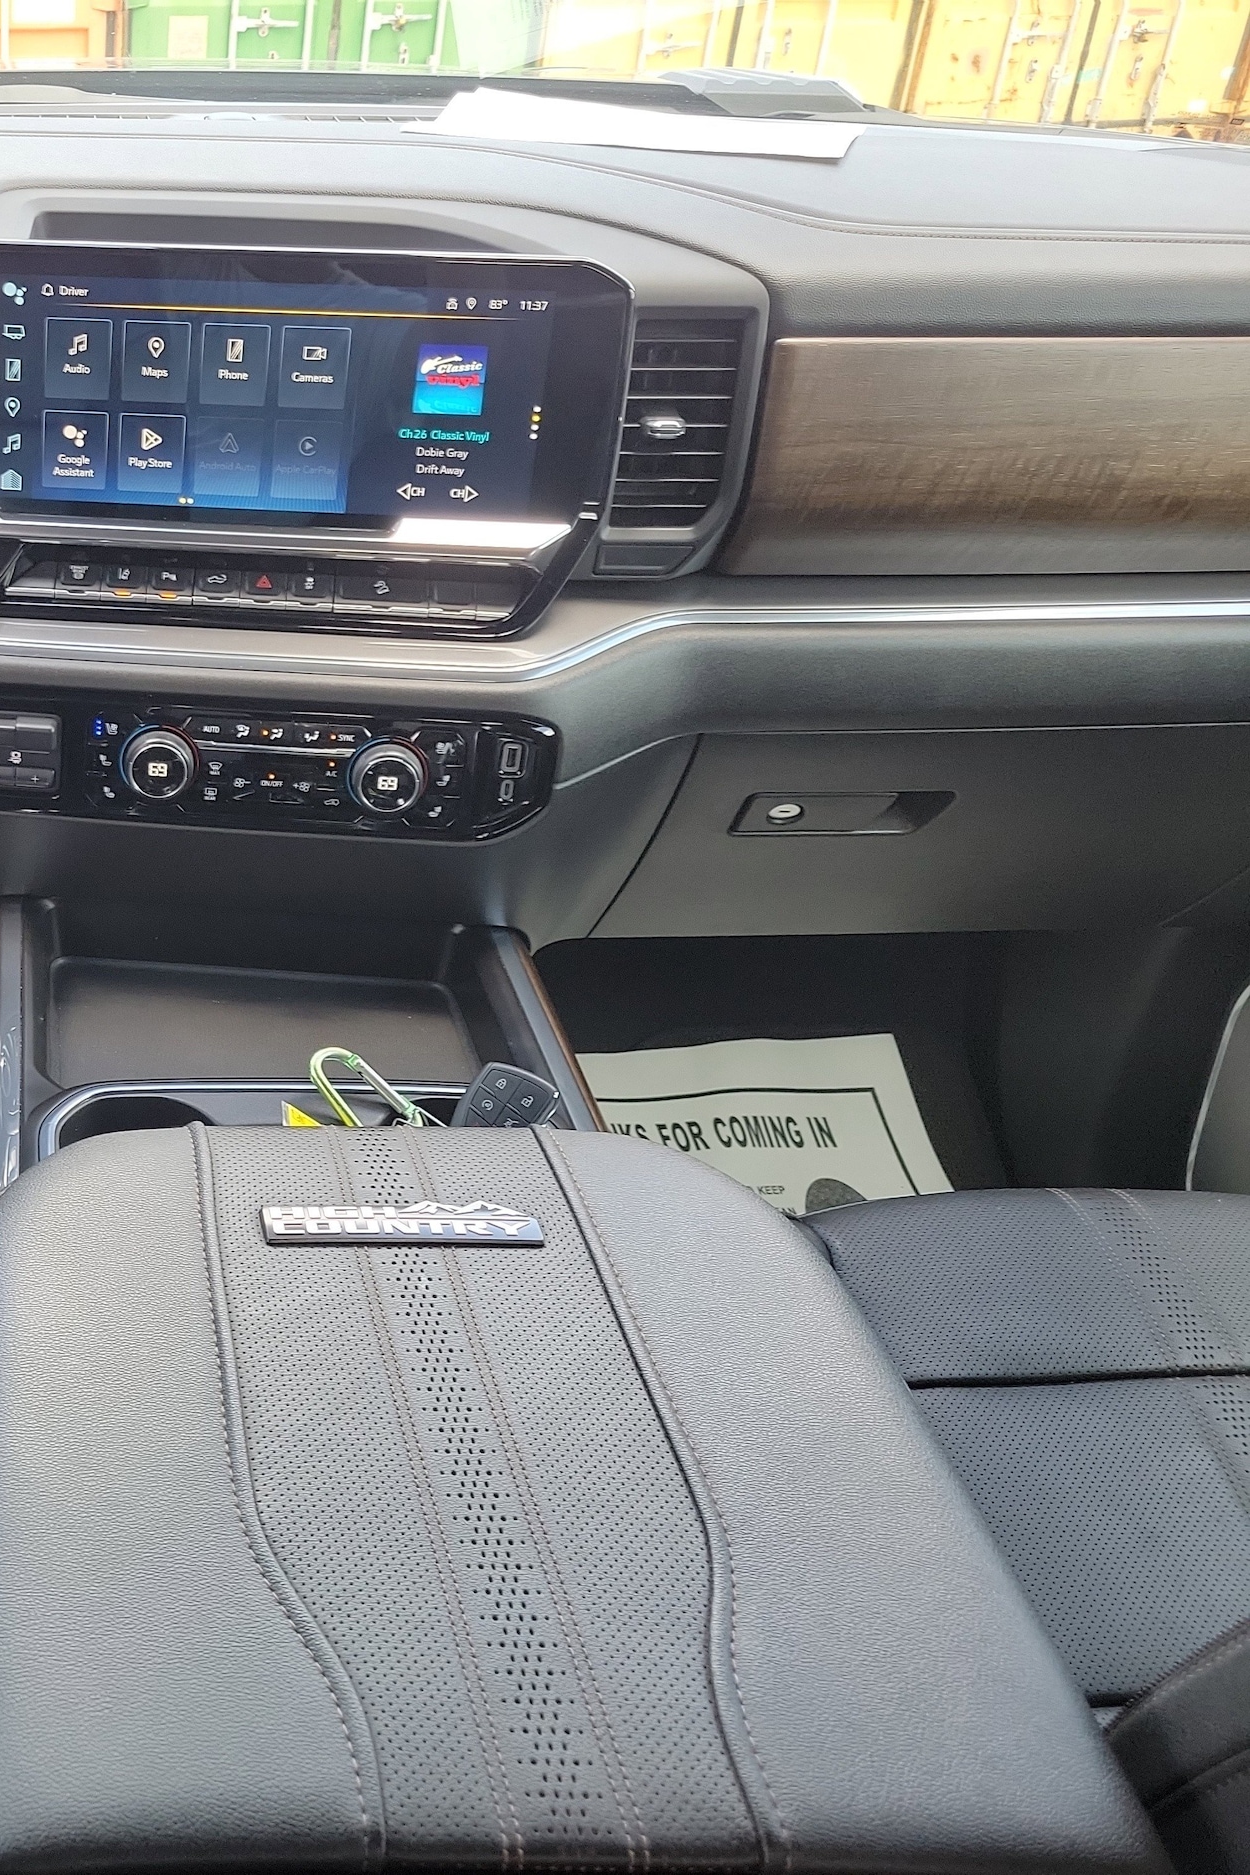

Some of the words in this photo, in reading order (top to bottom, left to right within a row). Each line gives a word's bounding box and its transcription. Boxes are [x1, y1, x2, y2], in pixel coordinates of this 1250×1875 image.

[58, 285, 89, 297] Driver
[520, 300, 548, 311] 11:37
[62, 363, 91, 375] Audio
[141, 366, 168, 379] Maps
[436, 361, 483, 374] Classic
[217, 369, 249, 381] Phone
[291, 371, 334, 384] Cameras
[430, 429, 464, 440] Classic
[464, 430, 490, 444] Vinyl
[415, 446, 445, 457] Dobie
[446, 448, 469, 461] Gray
[56, 453, 91, 467] Google
[127, 456, 148, 470] Play
[148, 458, 173, 469] Store
[52, 466, 95, 478] Assistant
[415, 463, 439, 475] Drift
[439, 464, 465, 478] Away
[410, 486, 426, 497] CH
[449, 488, 465, 498] CH
[202, 725, 221, 734] AUTO
[337, 733, 356, 742] SYNC
[260, 779, 284, 787] ON/OFF
[655, 1121, 710, 1152] FOR
[713, 1115, 805, 1149] COMING
[806, 1116, 838, 1148] IN
[757, 1185, 785, 1195] KEEP
[268, 1205, 398, 1220] HIGH
[271, 1219, 531, 1237] COUNTRY
